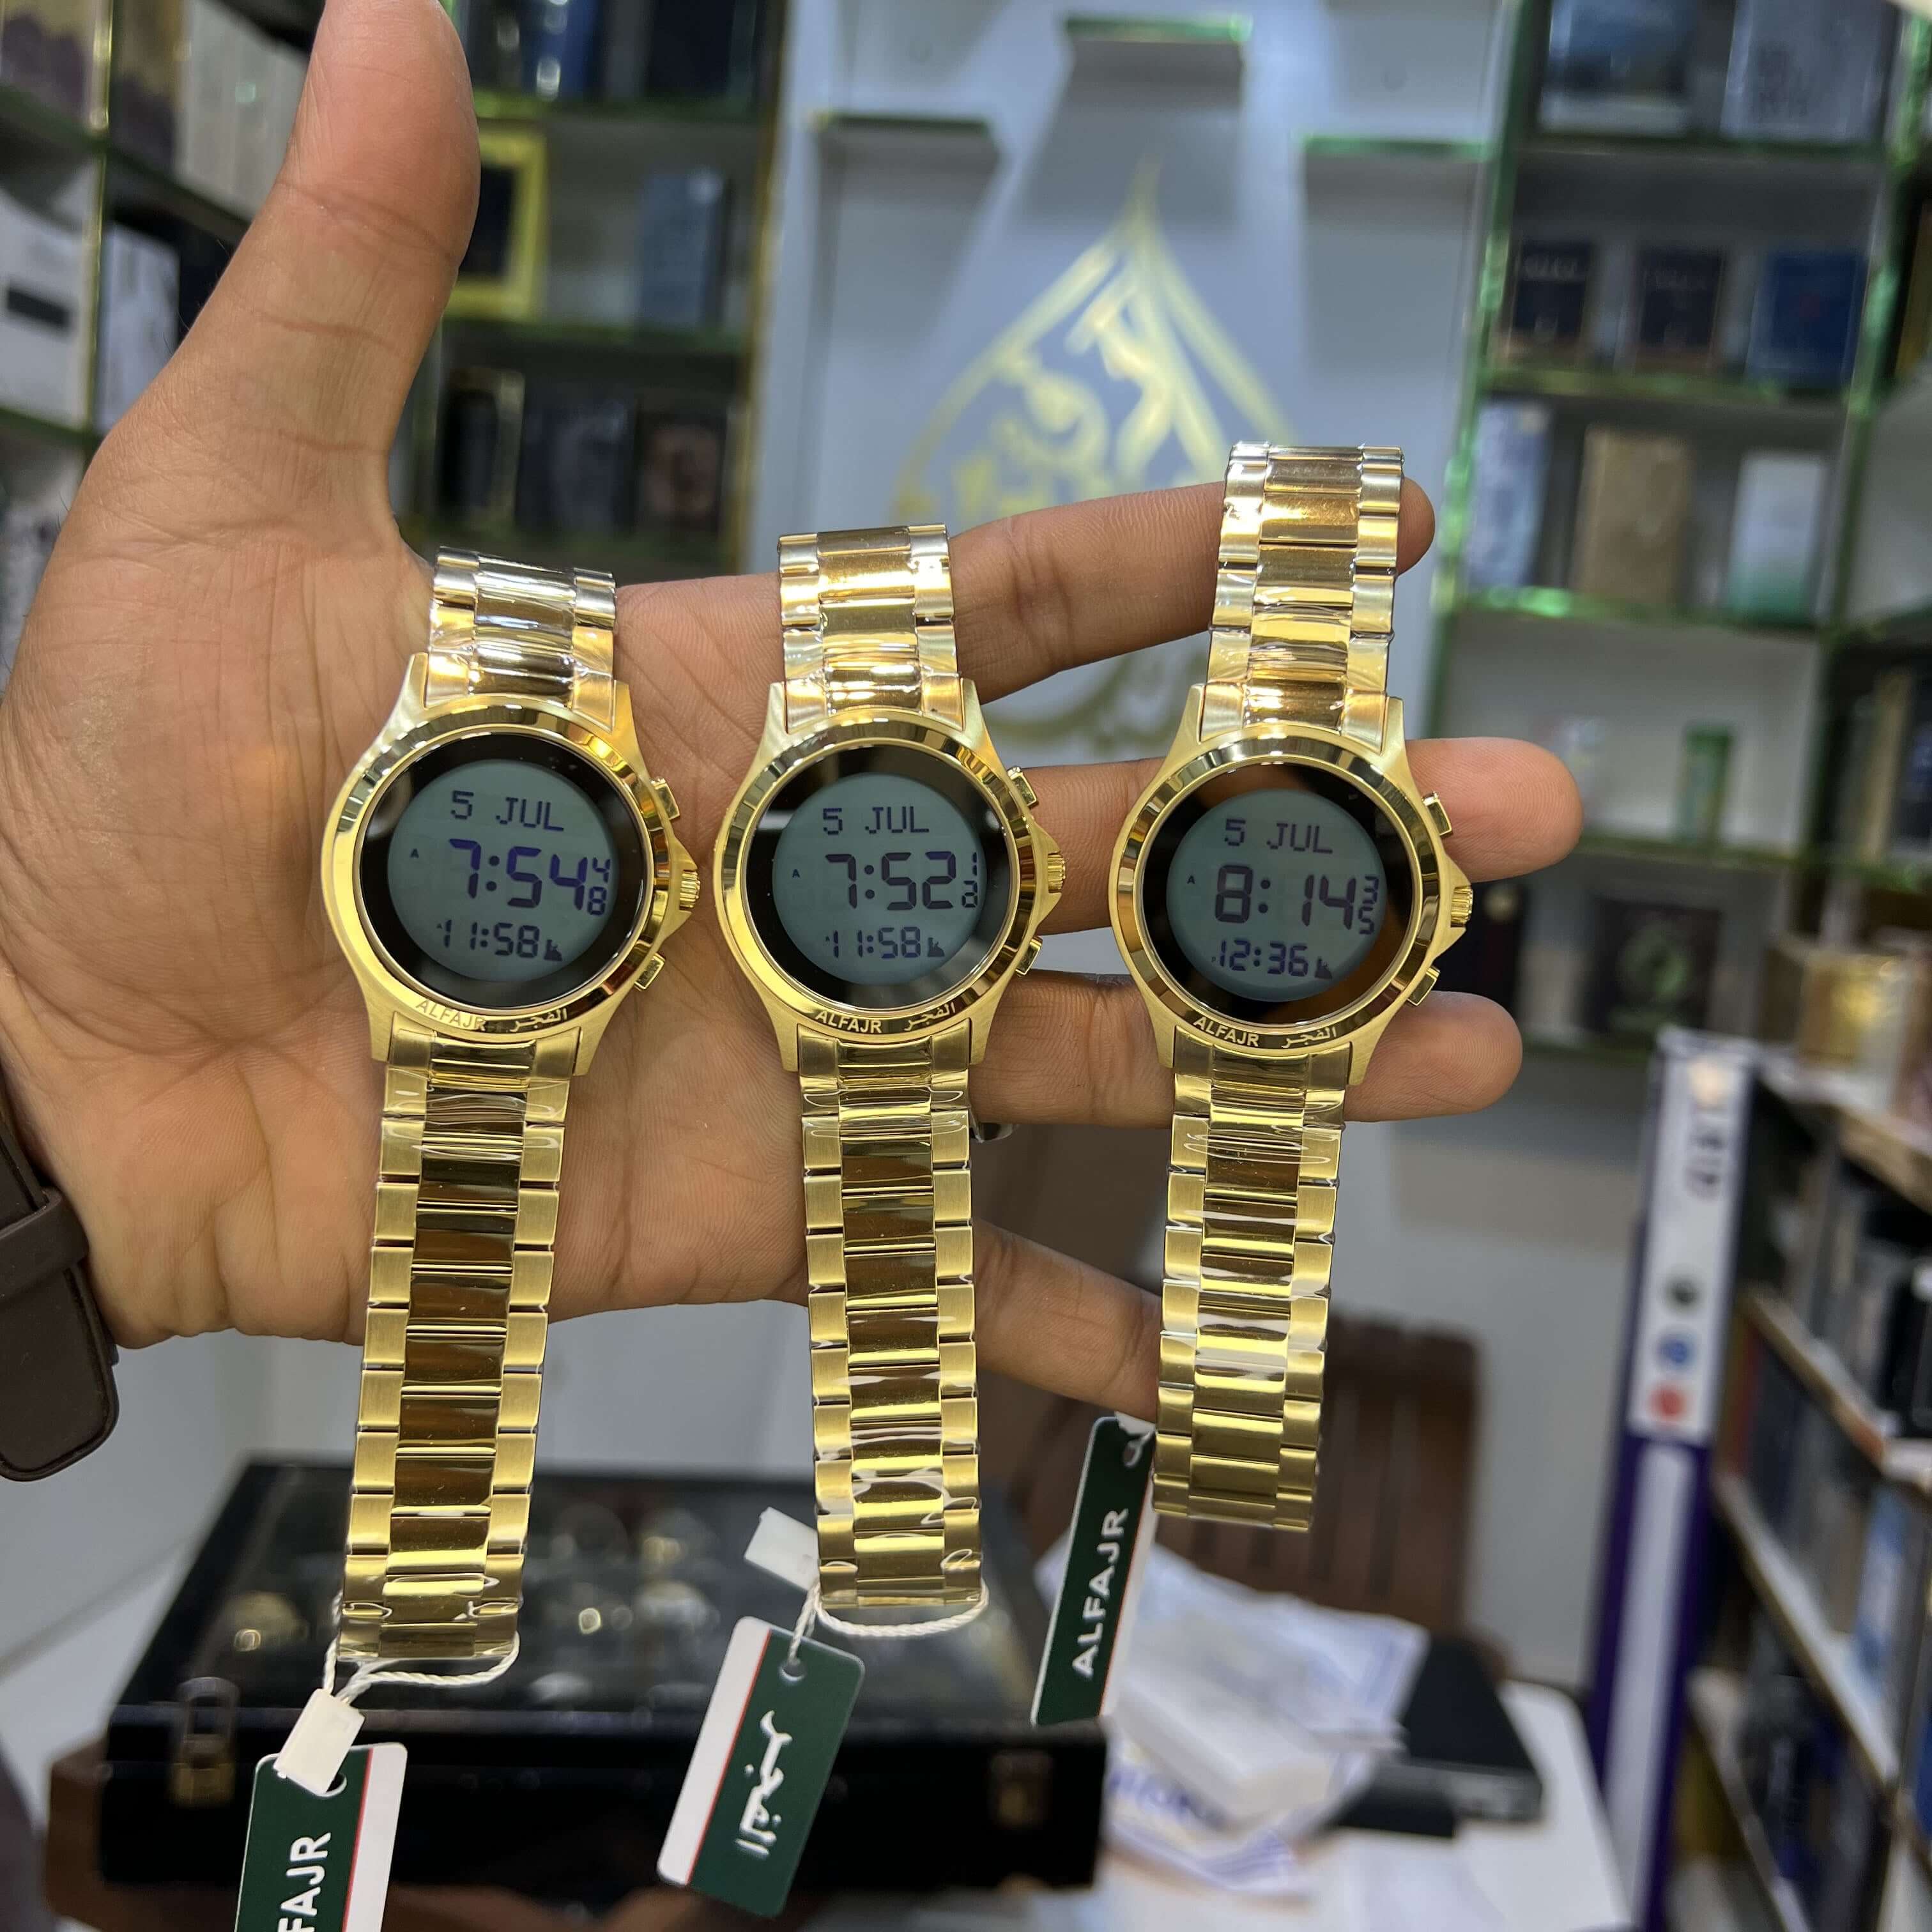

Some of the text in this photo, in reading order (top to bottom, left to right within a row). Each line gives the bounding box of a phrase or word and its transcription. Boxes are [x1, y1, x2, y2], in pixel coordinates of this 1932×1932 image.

[451, 790, 564, 831] 5 JUL
[823, 806, 930, 835] 5 JUL
[1225, 818, 1333, 854] 5 JUL
[449, 839, 588, 910] 7:54
[825, 851, 956, 910] 7:52
[444, 919, 540, 958] 11:58
[834, 927, 921, 958] 11:58
[1219, 940, 1308, 977] 12:36
[415, 999, 486, 1031] ALFAJR
[510, 1008, 567, 1032] الفجر
[816, 1011, 882, 1033] ALFAJR
[905, 1003, 956, 1031] الفجر
[1193, 1017, 1259, 1046] ALFAJR
[1282, 1026, 1337, 1048] الفجر
[1072, 1508, 1128, 1680] ALFAJR
